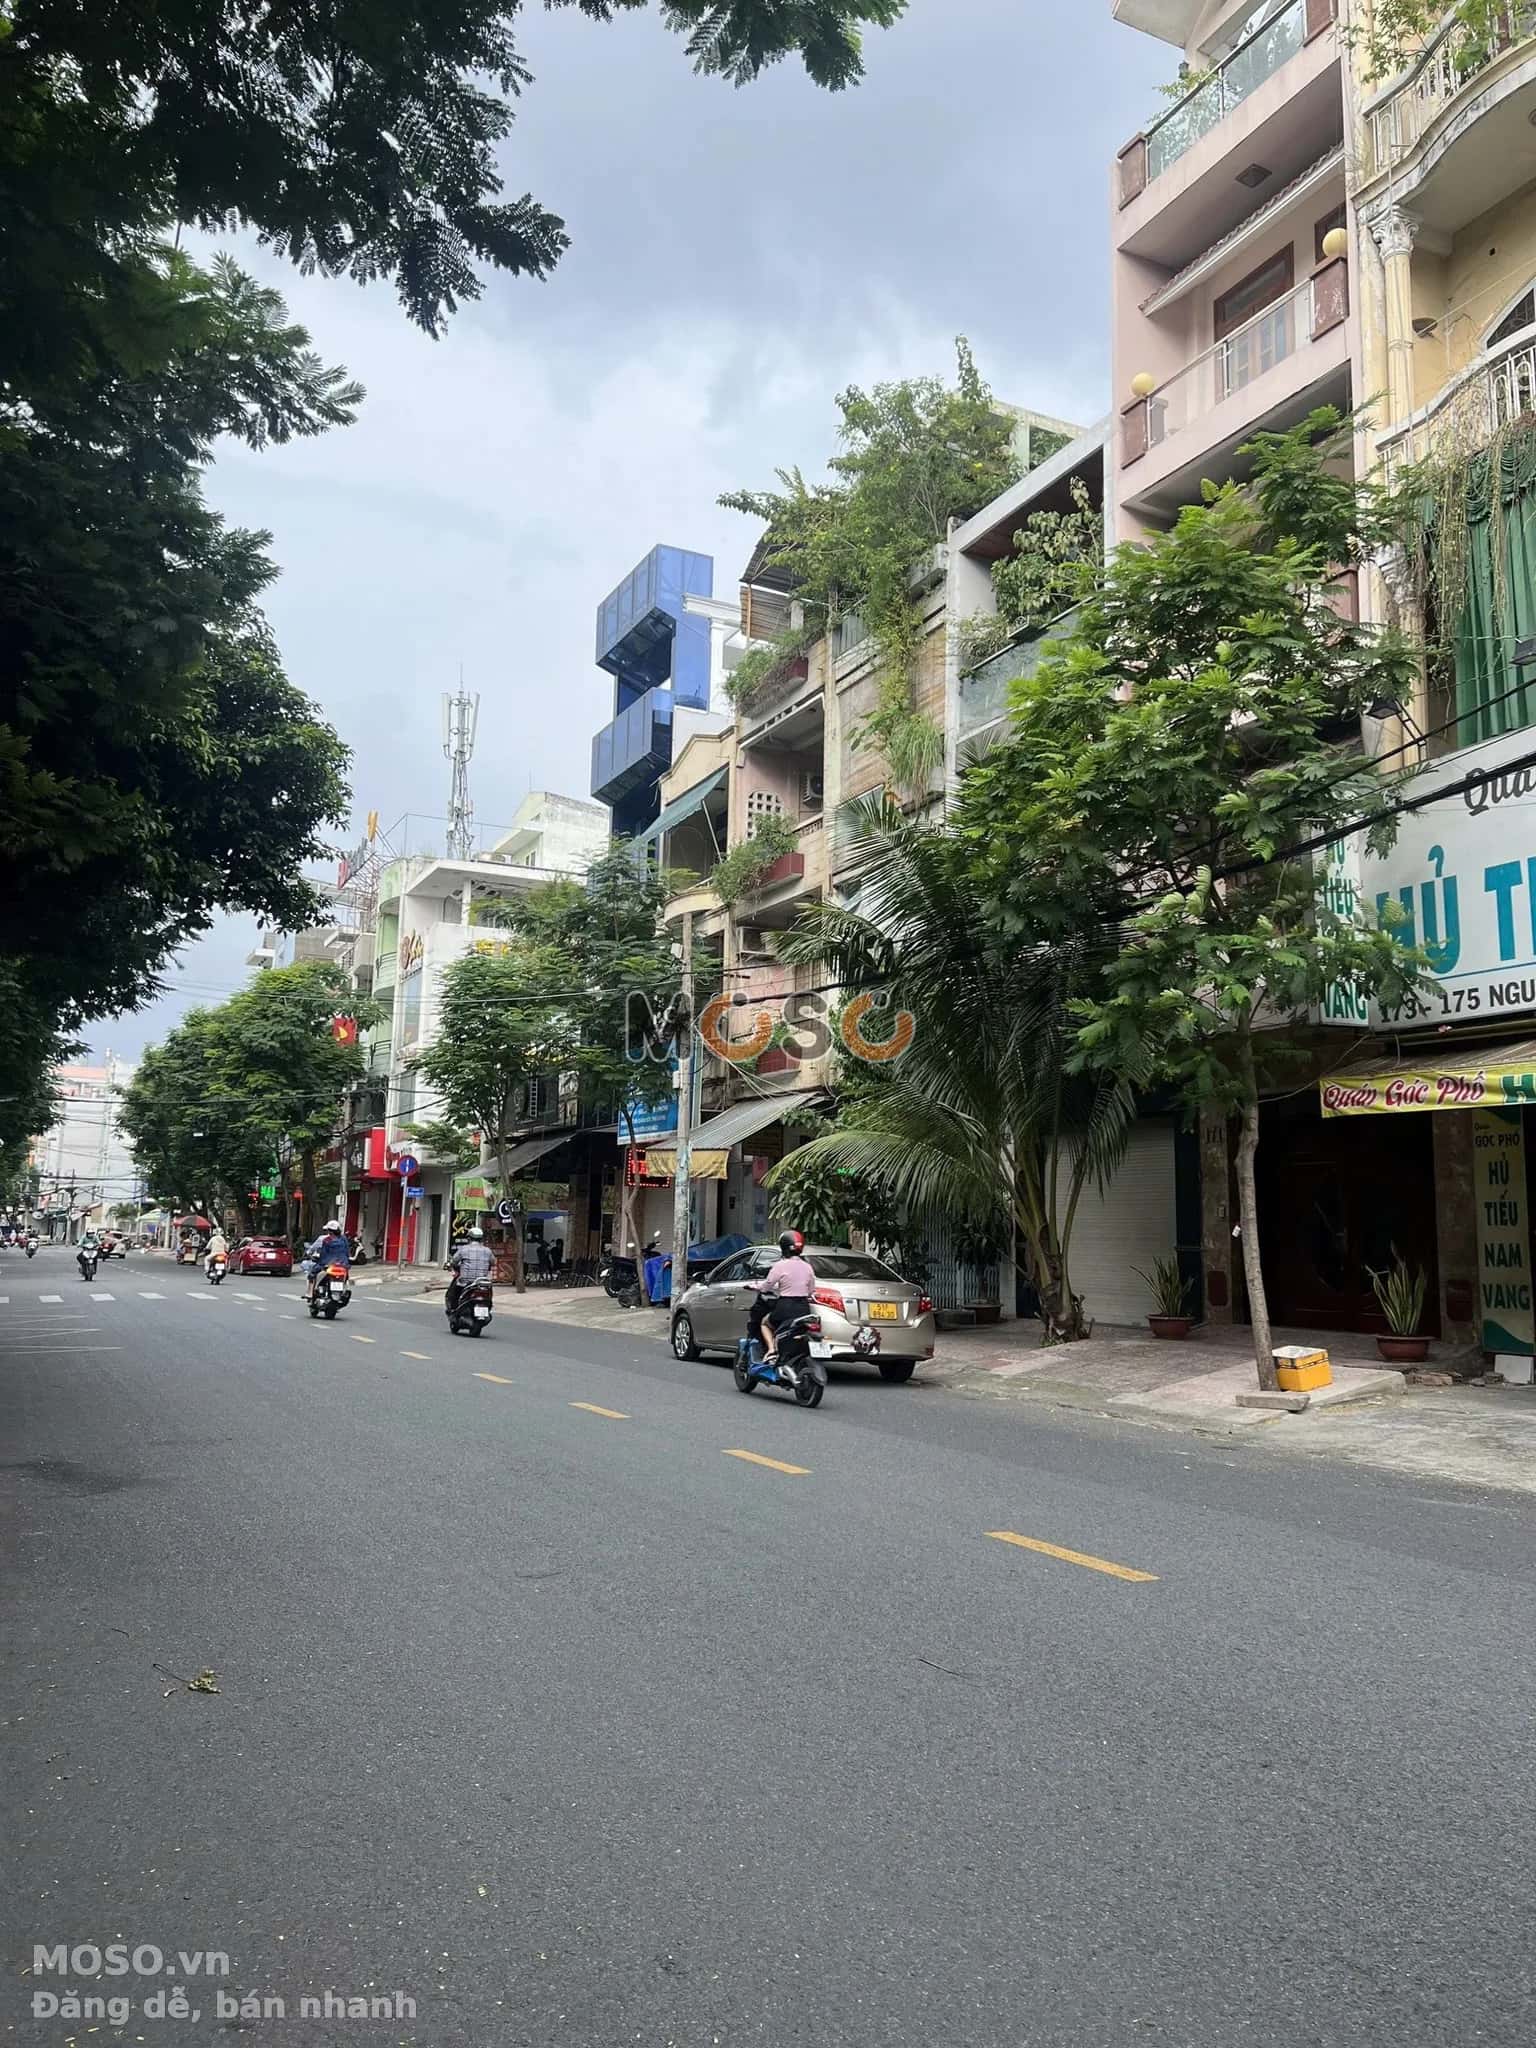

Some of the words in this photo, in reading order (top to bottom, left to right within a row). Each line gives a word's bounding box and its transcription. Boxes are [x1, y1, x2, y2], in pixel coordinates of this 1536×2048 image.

[1376, 845, 1461, 976] HỦ
[1440, 988, 1480, 1015] 175
[1323, 1083, 1377, 1110] Quán
[1386, 1079, 1429, 1107] Góc
[1437, 1070, 1487, 1105] Phố
[1484, 1189, 1518, 1226] TIẾU
[1484, 1243, 1522, 1268] NAM
[1482, 1284, 1530, 1310] VANG
